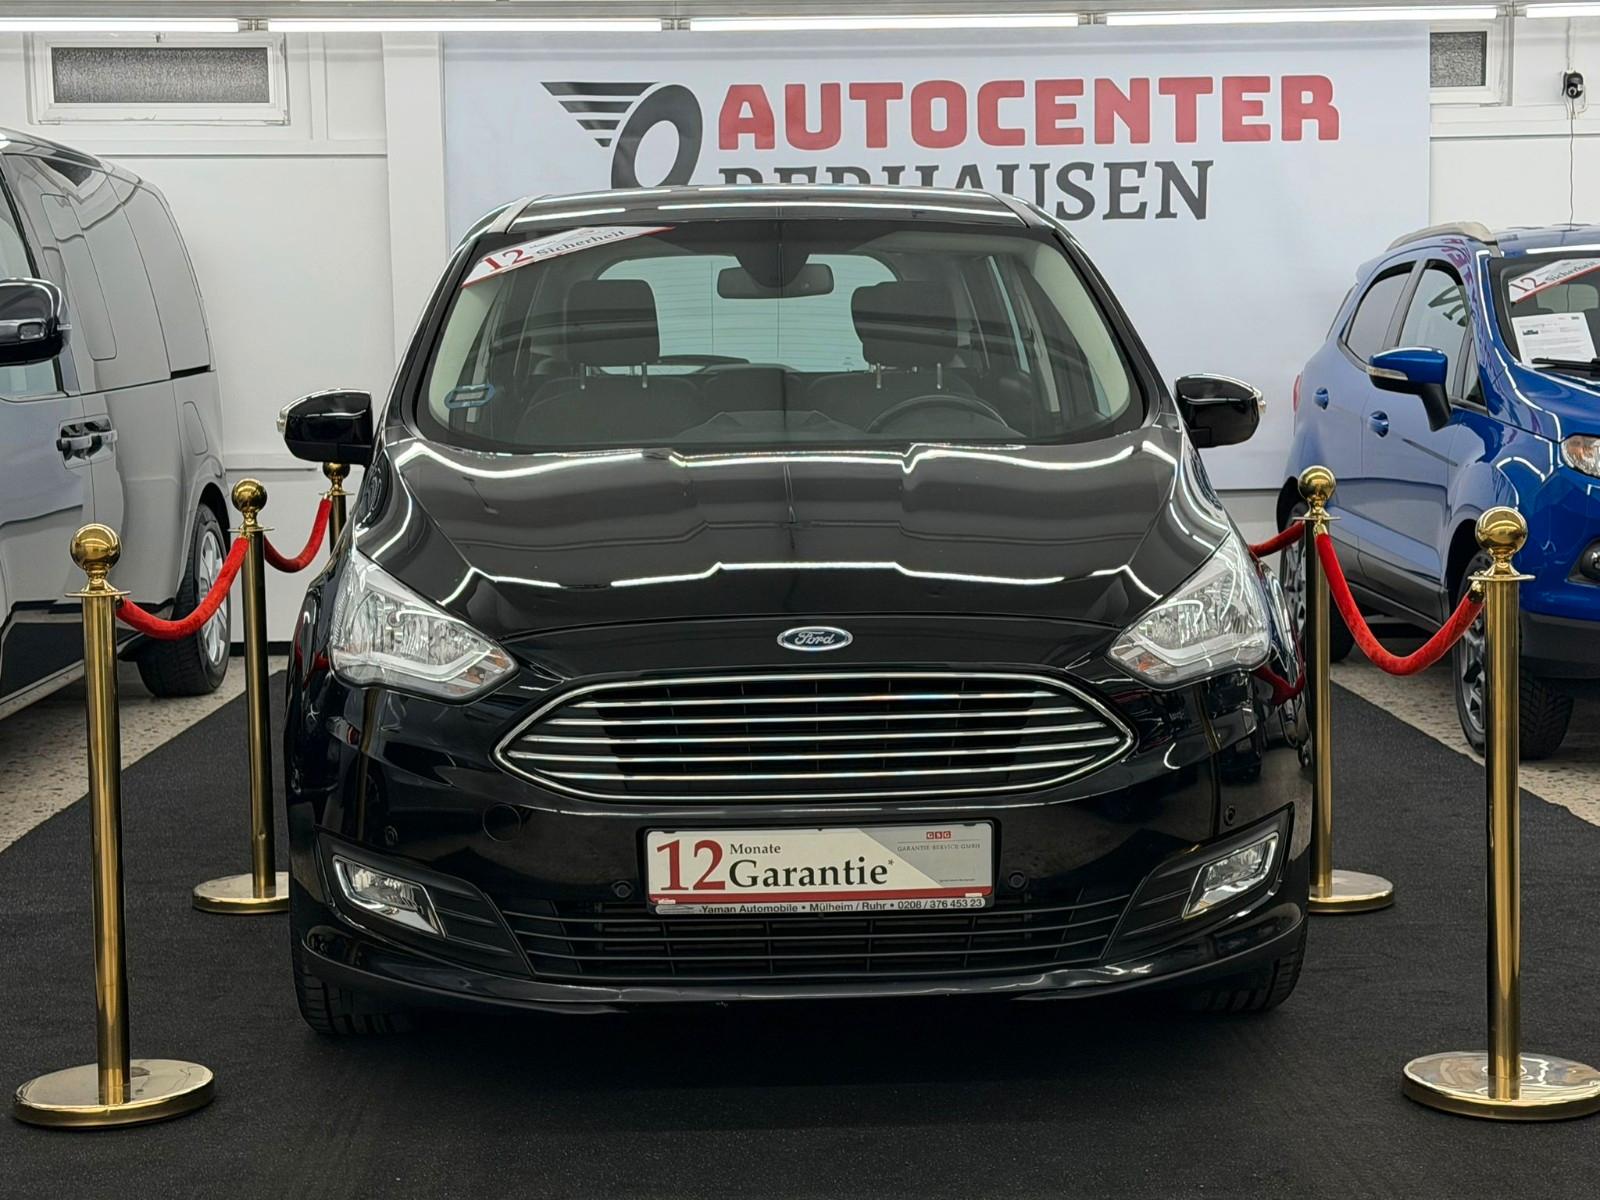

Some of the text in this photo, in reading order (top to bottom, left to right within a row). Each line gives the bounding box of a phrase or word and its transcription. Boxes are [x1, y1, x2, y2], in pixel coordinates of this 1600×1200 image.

[718, 75, 1340, 151] AUTOCENTER
[483, 229, 625, 272] 12 Sicherheit
[795, 631, 835, 645] Ford
[730, 843, 781, 855] Monate
[656, 839, 726, 891] 12
[700, 905, 737, 913] Yaman
[739, 903, 798, 913] Automobile
[809, 902, 854, 912] Mülheim
[862, 901, 887, 911] Ruhr
[897, 900, 922, 909] 0208
[930, 899, 948, 909] 376
[950, 898, 968, 908] 453
[970, 898, 983, 907] 23
